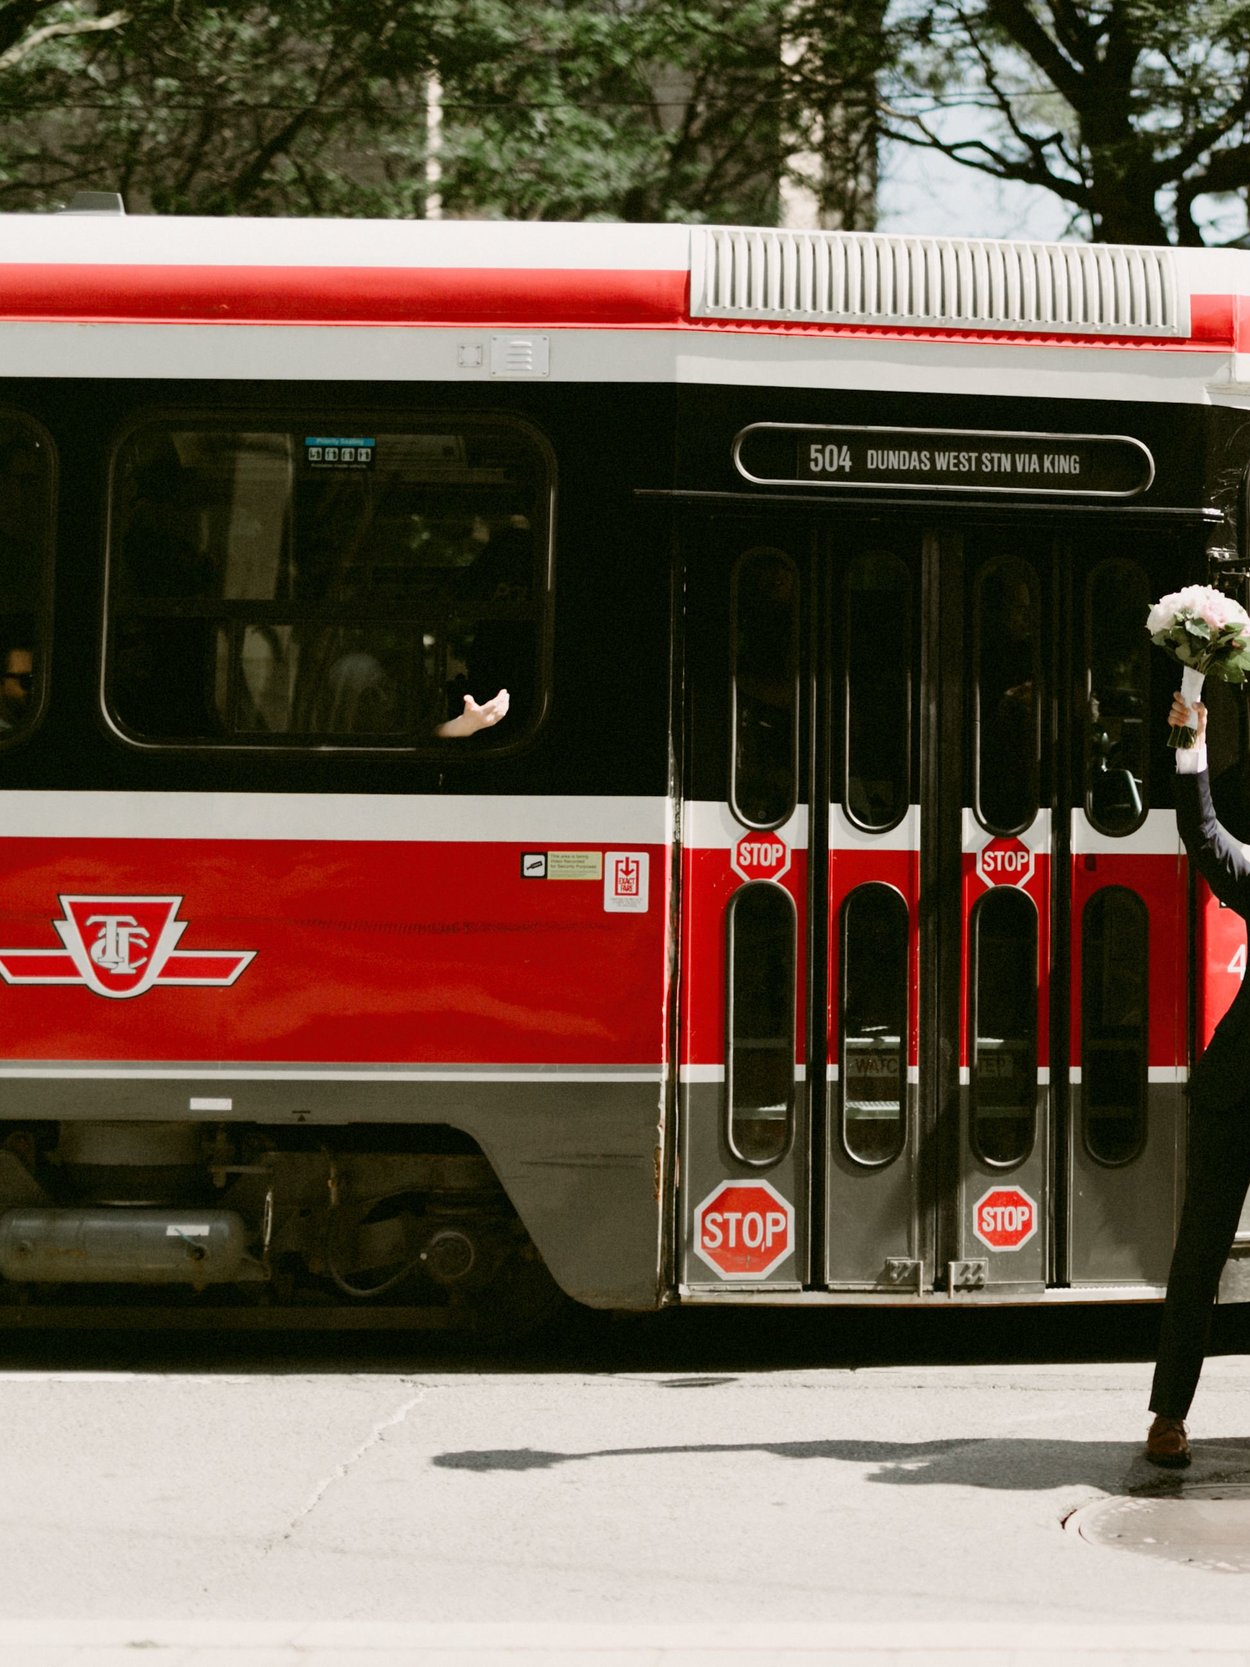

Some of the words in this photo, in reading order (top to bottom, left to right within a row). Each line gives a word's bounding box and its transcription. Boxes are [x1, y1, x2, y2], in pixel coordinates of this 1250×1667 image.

[810, 444, 852, 472] 504
[867, 450, 931, 470] DUNDAS
[935, 452, 978, 471] WEST
[982, 453, 1011, 472] STN
[1015, 453, 1040, 473] VIA
[1044, 454, 1079, 474] KING
[739, 842, 784, 867] STOP
[983, 851, 1029, 871] STOP
[854, 1058, 898, 1073] WATC
[703, 1212, 786, 1248] STOP
[982, 1206, 1030, 1232] STOP
